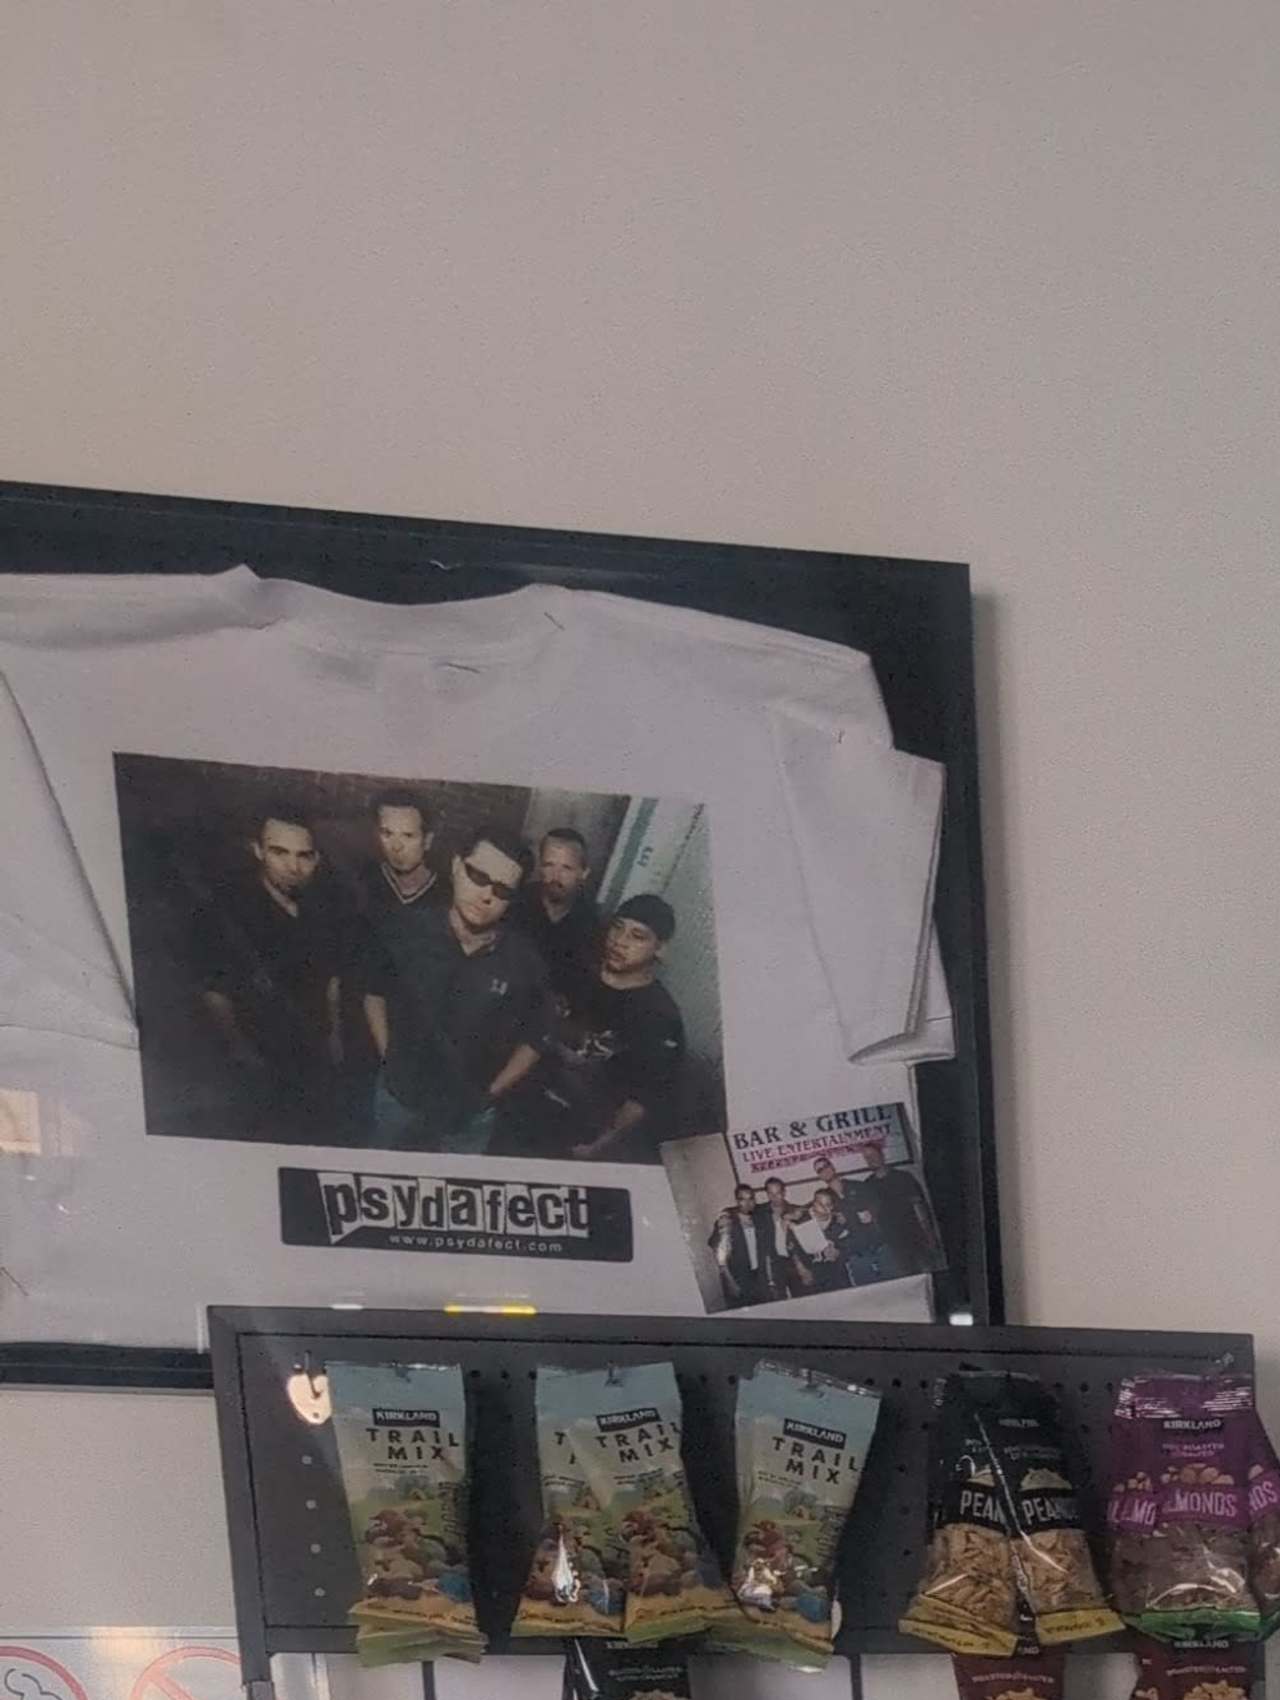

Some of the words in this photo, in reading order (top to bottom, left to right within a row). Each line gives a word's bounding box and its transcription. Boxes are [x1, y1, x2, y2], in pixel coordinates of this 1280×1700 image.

[733, 1126, 781, 1150] BAR
[789, 1120, 808, 1139] &
[816, 1106, 893, 1133] GRILL
[743, 1144, 773, 1163] LIVE
[323, 1182, 591, 1236] psydafect
[389, 1233, 563, 1253] www.psydafect.com
[366, 1427, 460, 1447] TRAIL
[595, 1422, 681, 1448] TRAIL
[387, 1446, 445, 1461] MIX
[619, 1437, 674, 1464] MIX
[772, 1436, 858, 1472] TRAIL
[785, 1458, 840, 1485] MIX
